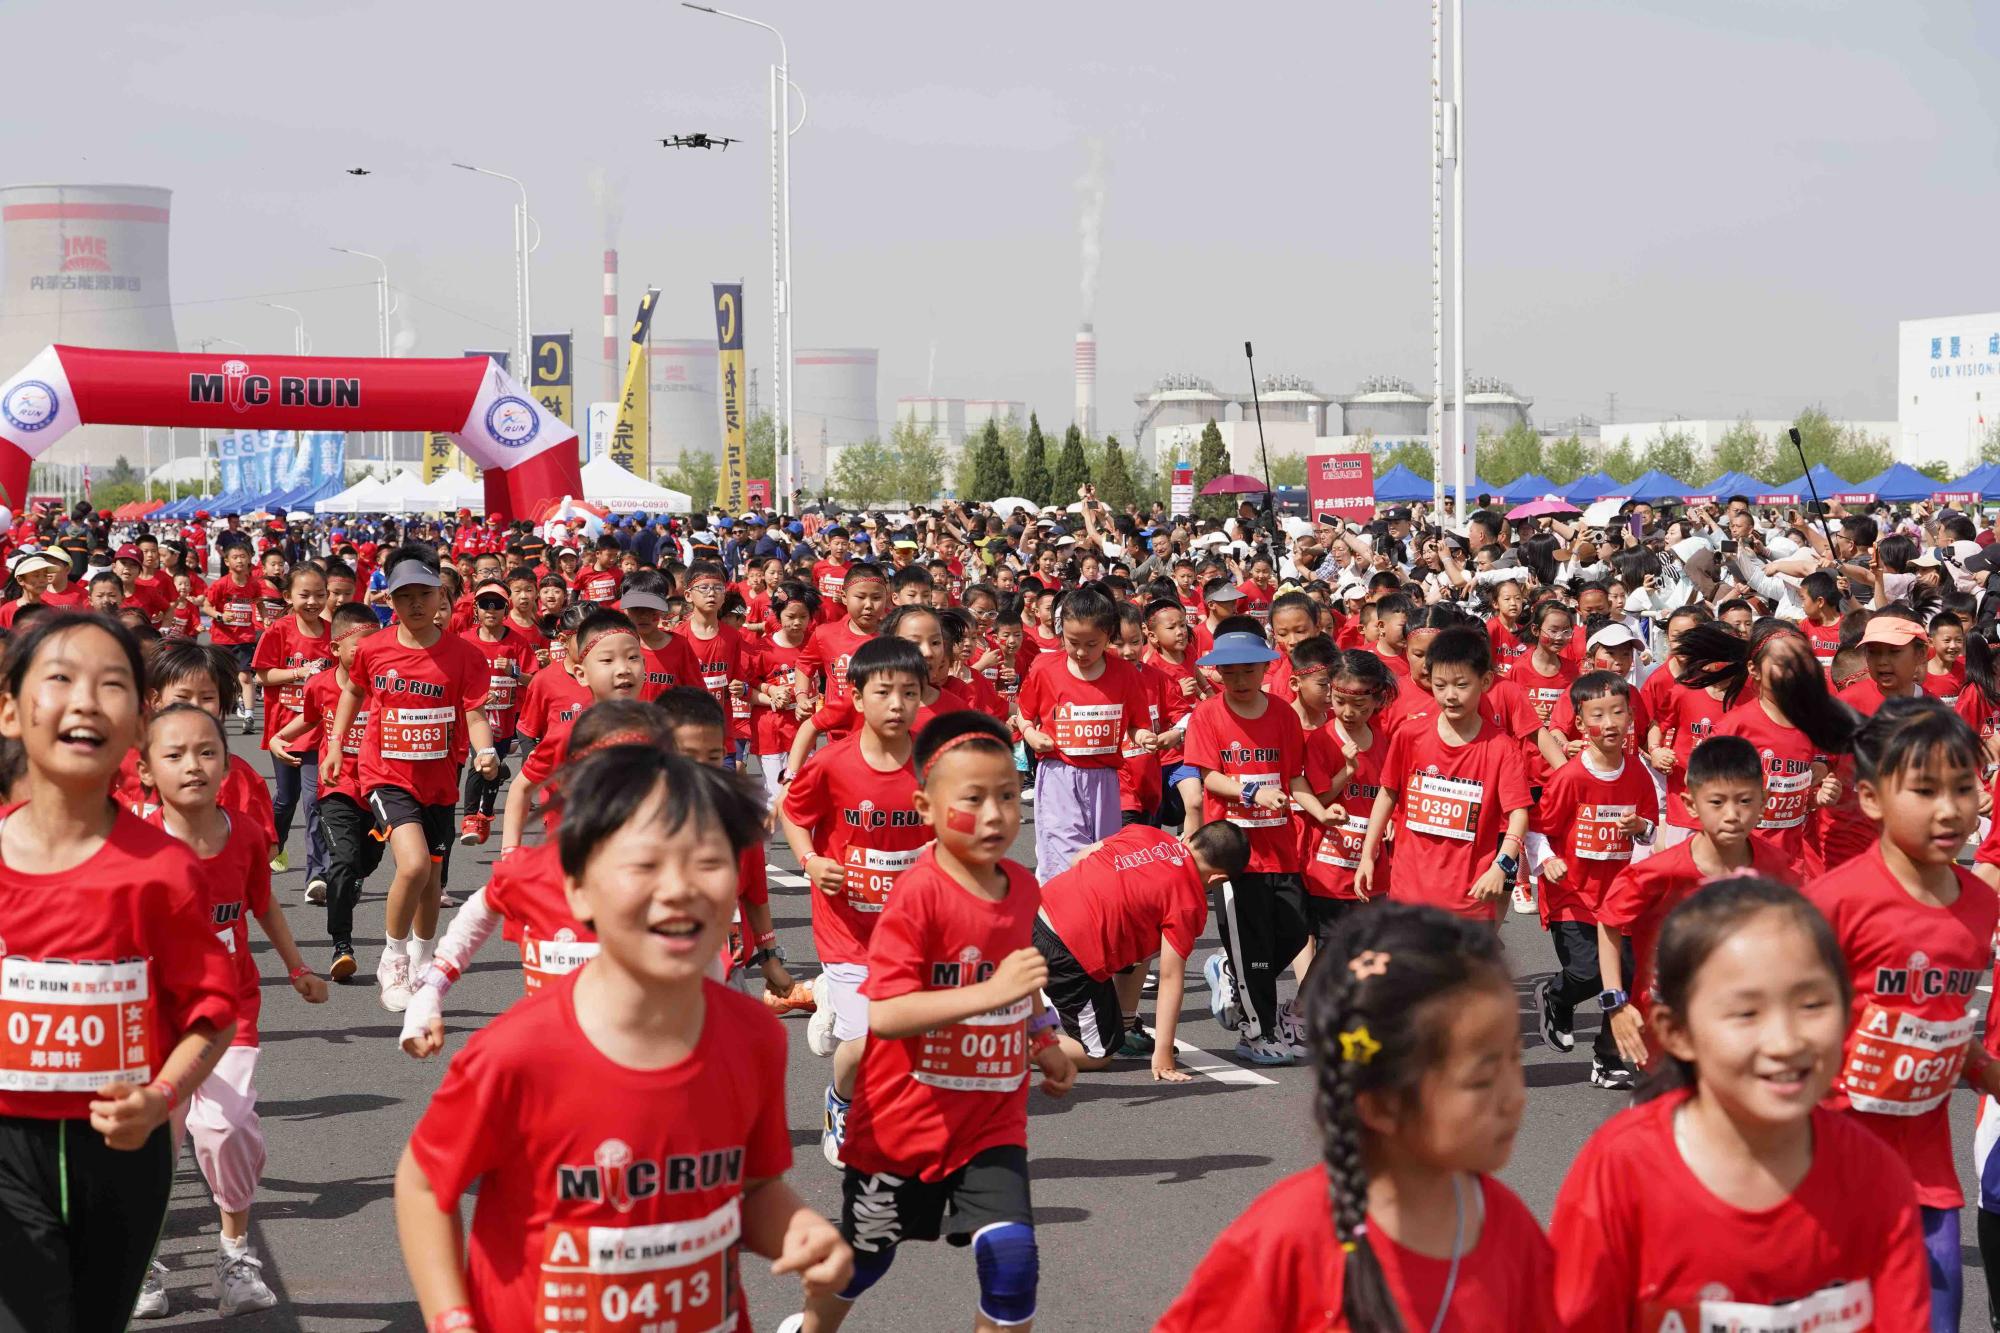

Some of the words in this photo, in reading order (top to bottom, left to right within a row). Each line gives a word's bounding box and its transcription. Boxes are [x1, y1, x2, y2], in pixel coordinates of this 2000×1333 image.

[279, 376, 360, 408] RUN
[503, 425, 526, 433] RUN
[836, 658, 845, 668] A
[374, 669, 406, 694] MIC
[409, 679, 446, 698] RUN
[1528, 689, 1536, 697] A
[326, 709, 334, 719] A
[385, 709, 396, 721] A
[401, 713, 414, 721] MIC
[1059, 708, 1068, 719] A
[402, 727, 442, 742] 0363
[1074, 724, 1110, 738] 0609
[1984, 725, 1992, 734] A
[1220, 741, 1251, 767] MIC
[1254, 748, 1280, 763] RUN
[1411, 776, 1420, 789] A
[1437, 785, 1451, 794] RUN
[1421, 798, 1463, 818] 0390
[1582, 806, 1592, 818] A
[1767, 795, 1802, 810] 0723
[843, 800, 887, 832] MIC
[850, 849, 862, 864] A
[869, 857, 884, 865] MIC
[885, 858, 902, 866] RUN
[869, 875, 894, 892] 05
[525, 942, 538, 964] A
[544, 951, 566, 965] MIC
[931, 945, 995, 988] MIC
[1874, 951, 1944, 1004] MIC
[9, 972, 35, 991] MIC
[39, 980, 69, 993] RUN
[7, 1011, 105, 1048] 0740
[125, 1004, 145, 1064] 女子组
[1867, 1010, 1889, 1034] A
[1901, 1023, 1928, 1040] MIC
[961, 1031, 1022, 1058] 0018
[1893, 1053, 1957, 1084] 0621
[557, 1139, 660, 1212] MIC
[664, 1146, 746, 1195] RUN
[550, 1231, 580, 1264] A
[600, 1239, 636, 1261] MIC
[640, 1243, 678, 1260] RUN
[600, 1270, 711, 1323] 0413
[1657, 1309, 1688, 1333] A
